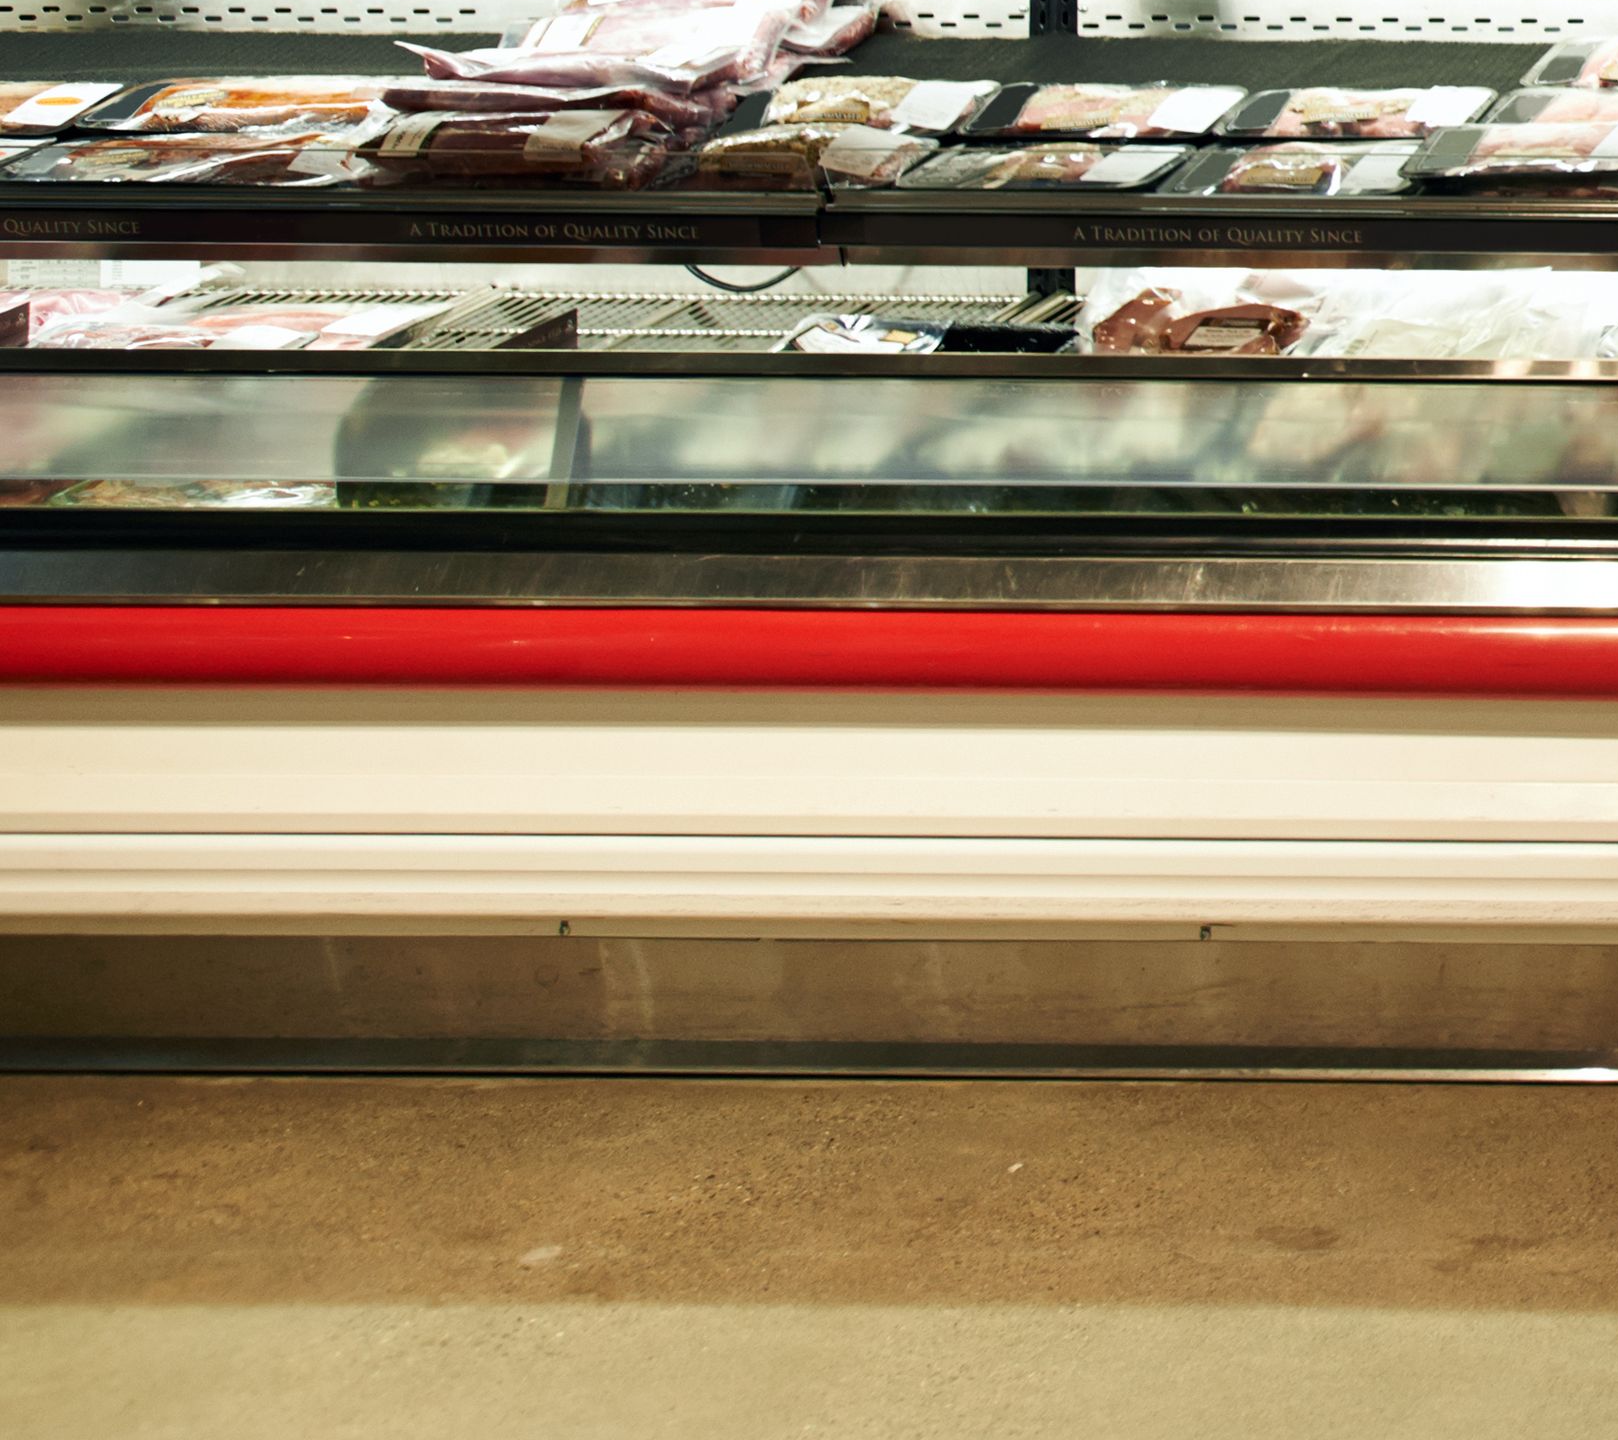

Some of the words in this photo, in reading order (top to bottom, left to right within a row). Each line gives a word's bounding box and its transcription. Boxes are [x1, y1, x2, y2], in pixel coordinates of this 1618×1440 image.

[409, 222, 421, 237] A
[427, 222, 528, 237] TRADITION
[534, 222, 557, 237] OF
[563, 222, 641, 240] QUALITY
[647, 222, 700, 238] SINCE
